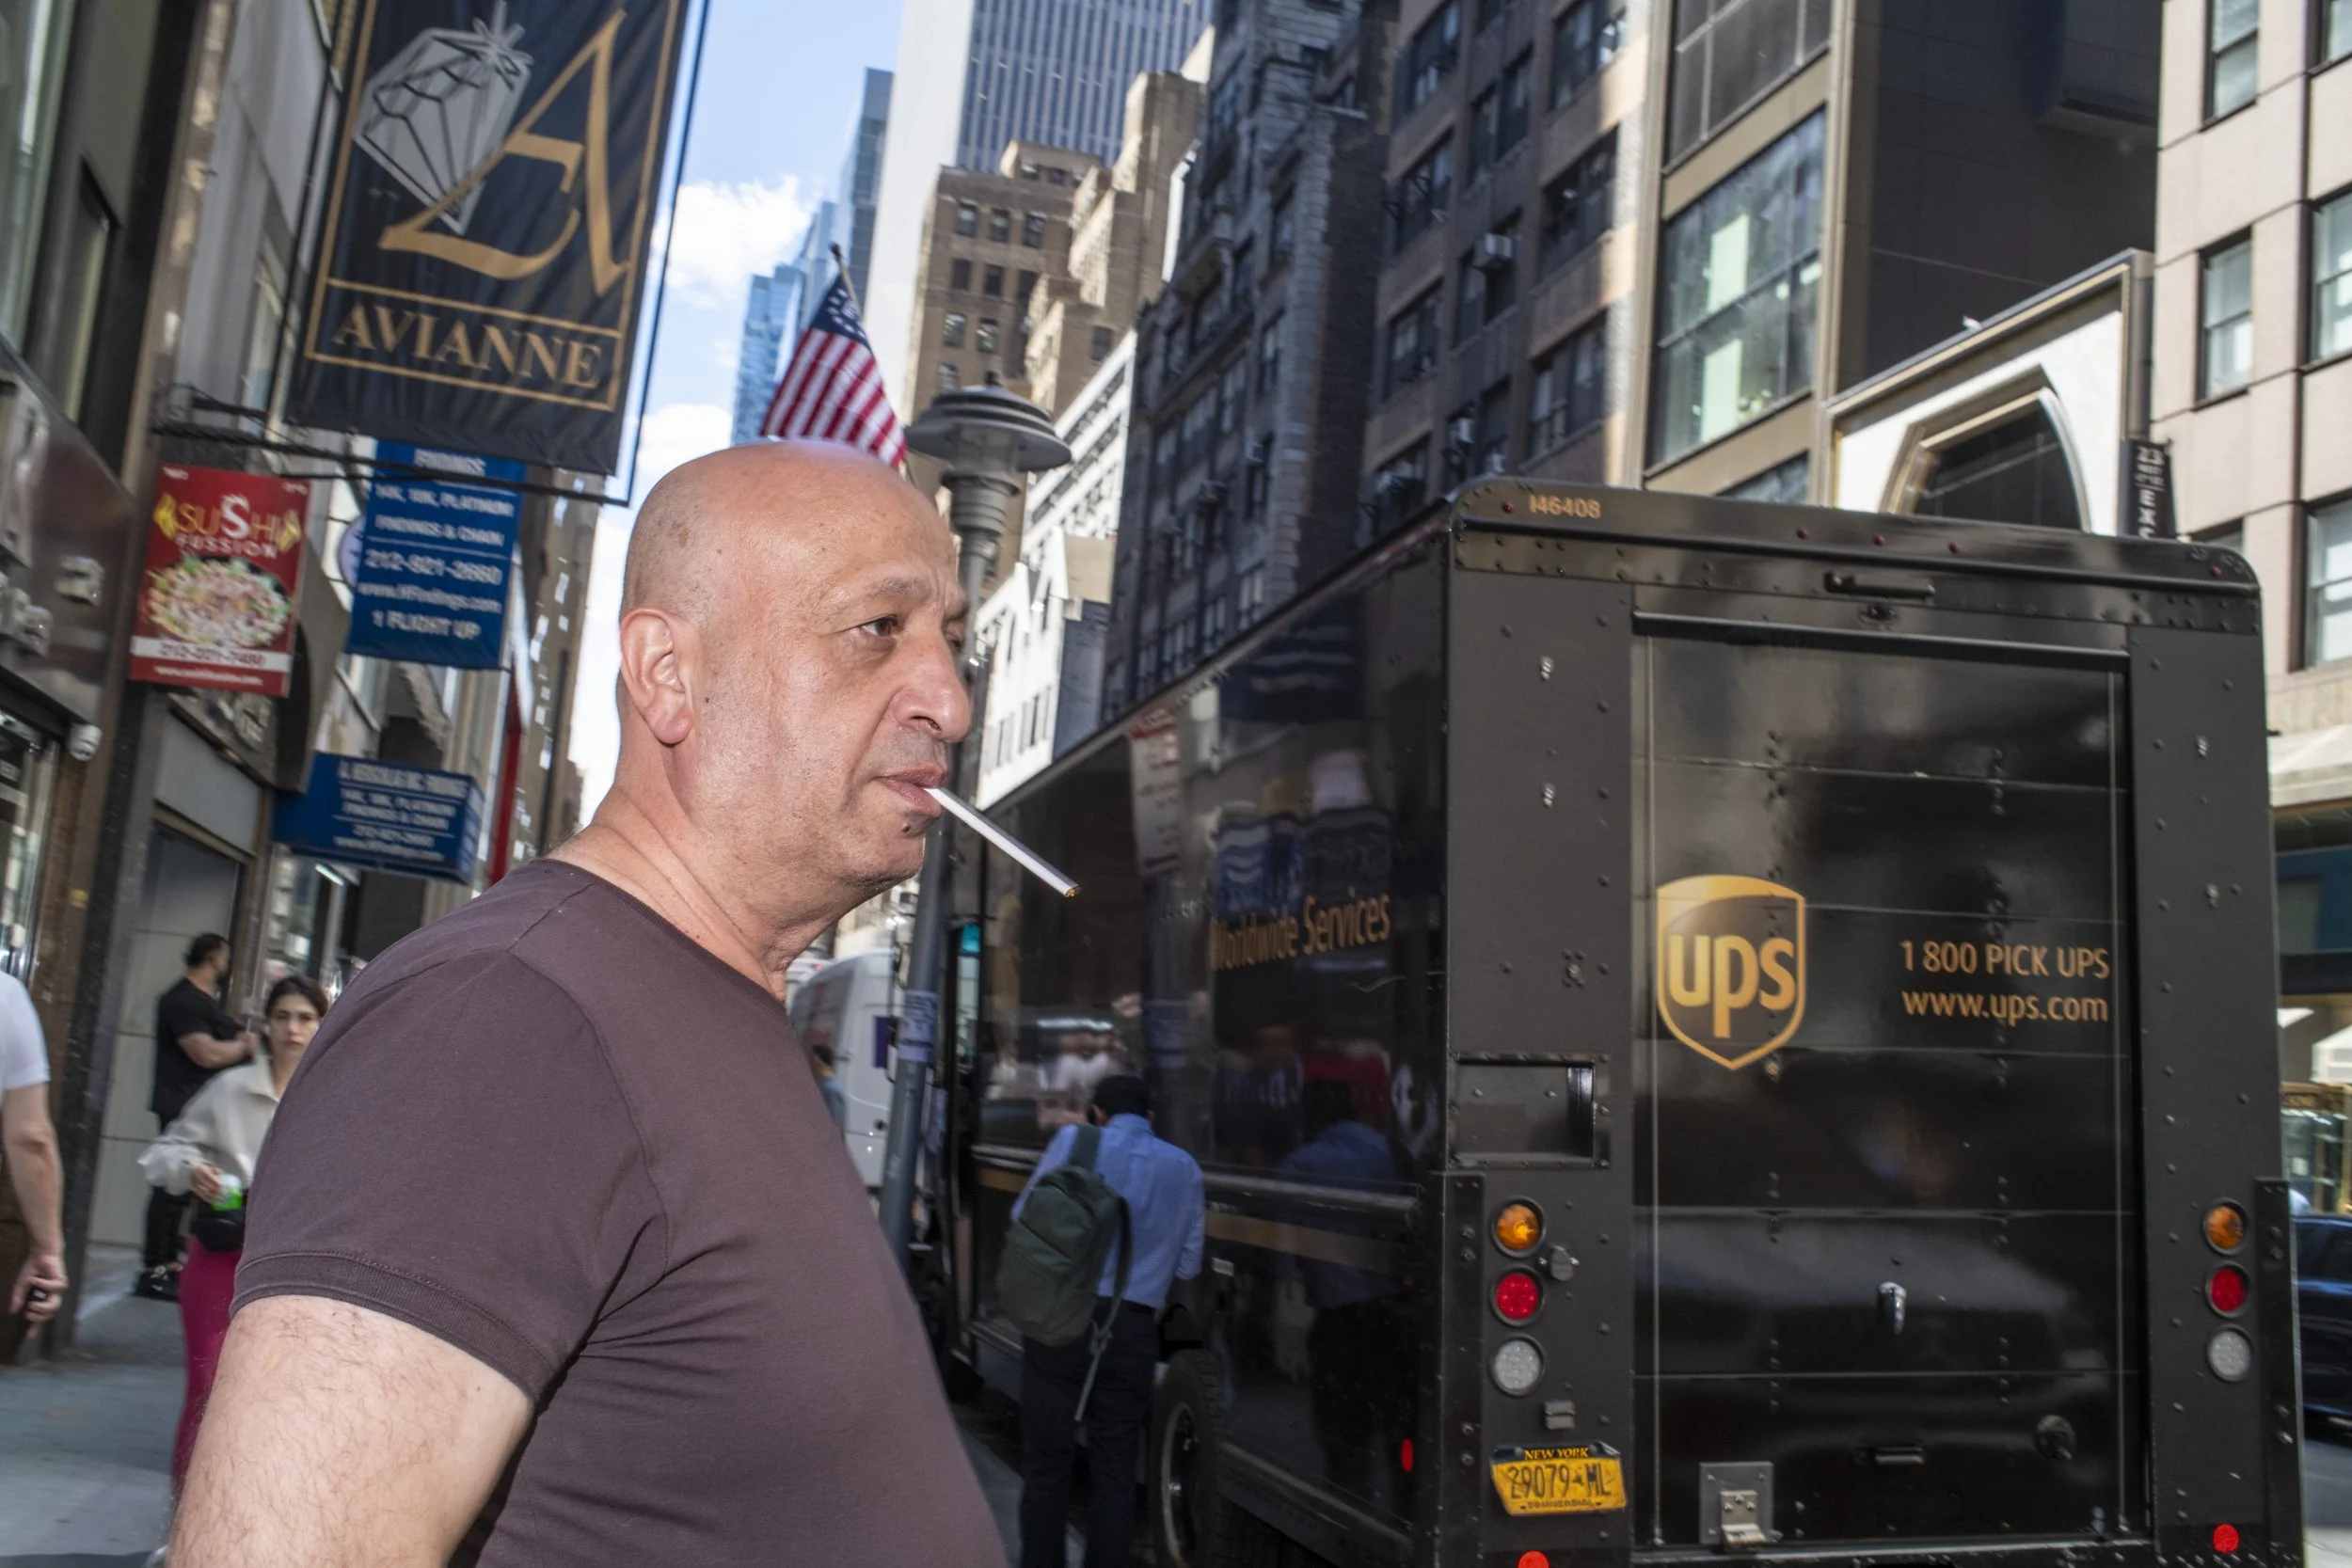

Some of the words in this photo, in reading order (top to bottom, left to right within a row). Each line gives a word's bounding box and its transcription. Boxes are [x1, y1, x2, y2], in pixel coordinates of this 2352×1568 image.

[332, 303, 602, 388] AVIANNE
[177, 494, 278, 543] SUSHI
[175, 534, 277, 559] FUSSION
[386, 610, 452, 636] FLIGHT
[453, 619, 482, 641] UP
[1302, 884, 1391, 956] Services
[1899, 940, 1914, 972] 1
[1922, 941, 1978, 974] 800
[1985, 943, 2050, 977] PICK
[2057, 946, 2110, 979] UPS
[1669, 934, 1797, 1039] ups
[1901, 990, 2108, 1027] www.ups.com
[1524, 1449, 1555, 1460] NEW
[1557, 1447, 1589, 1458] YORK
